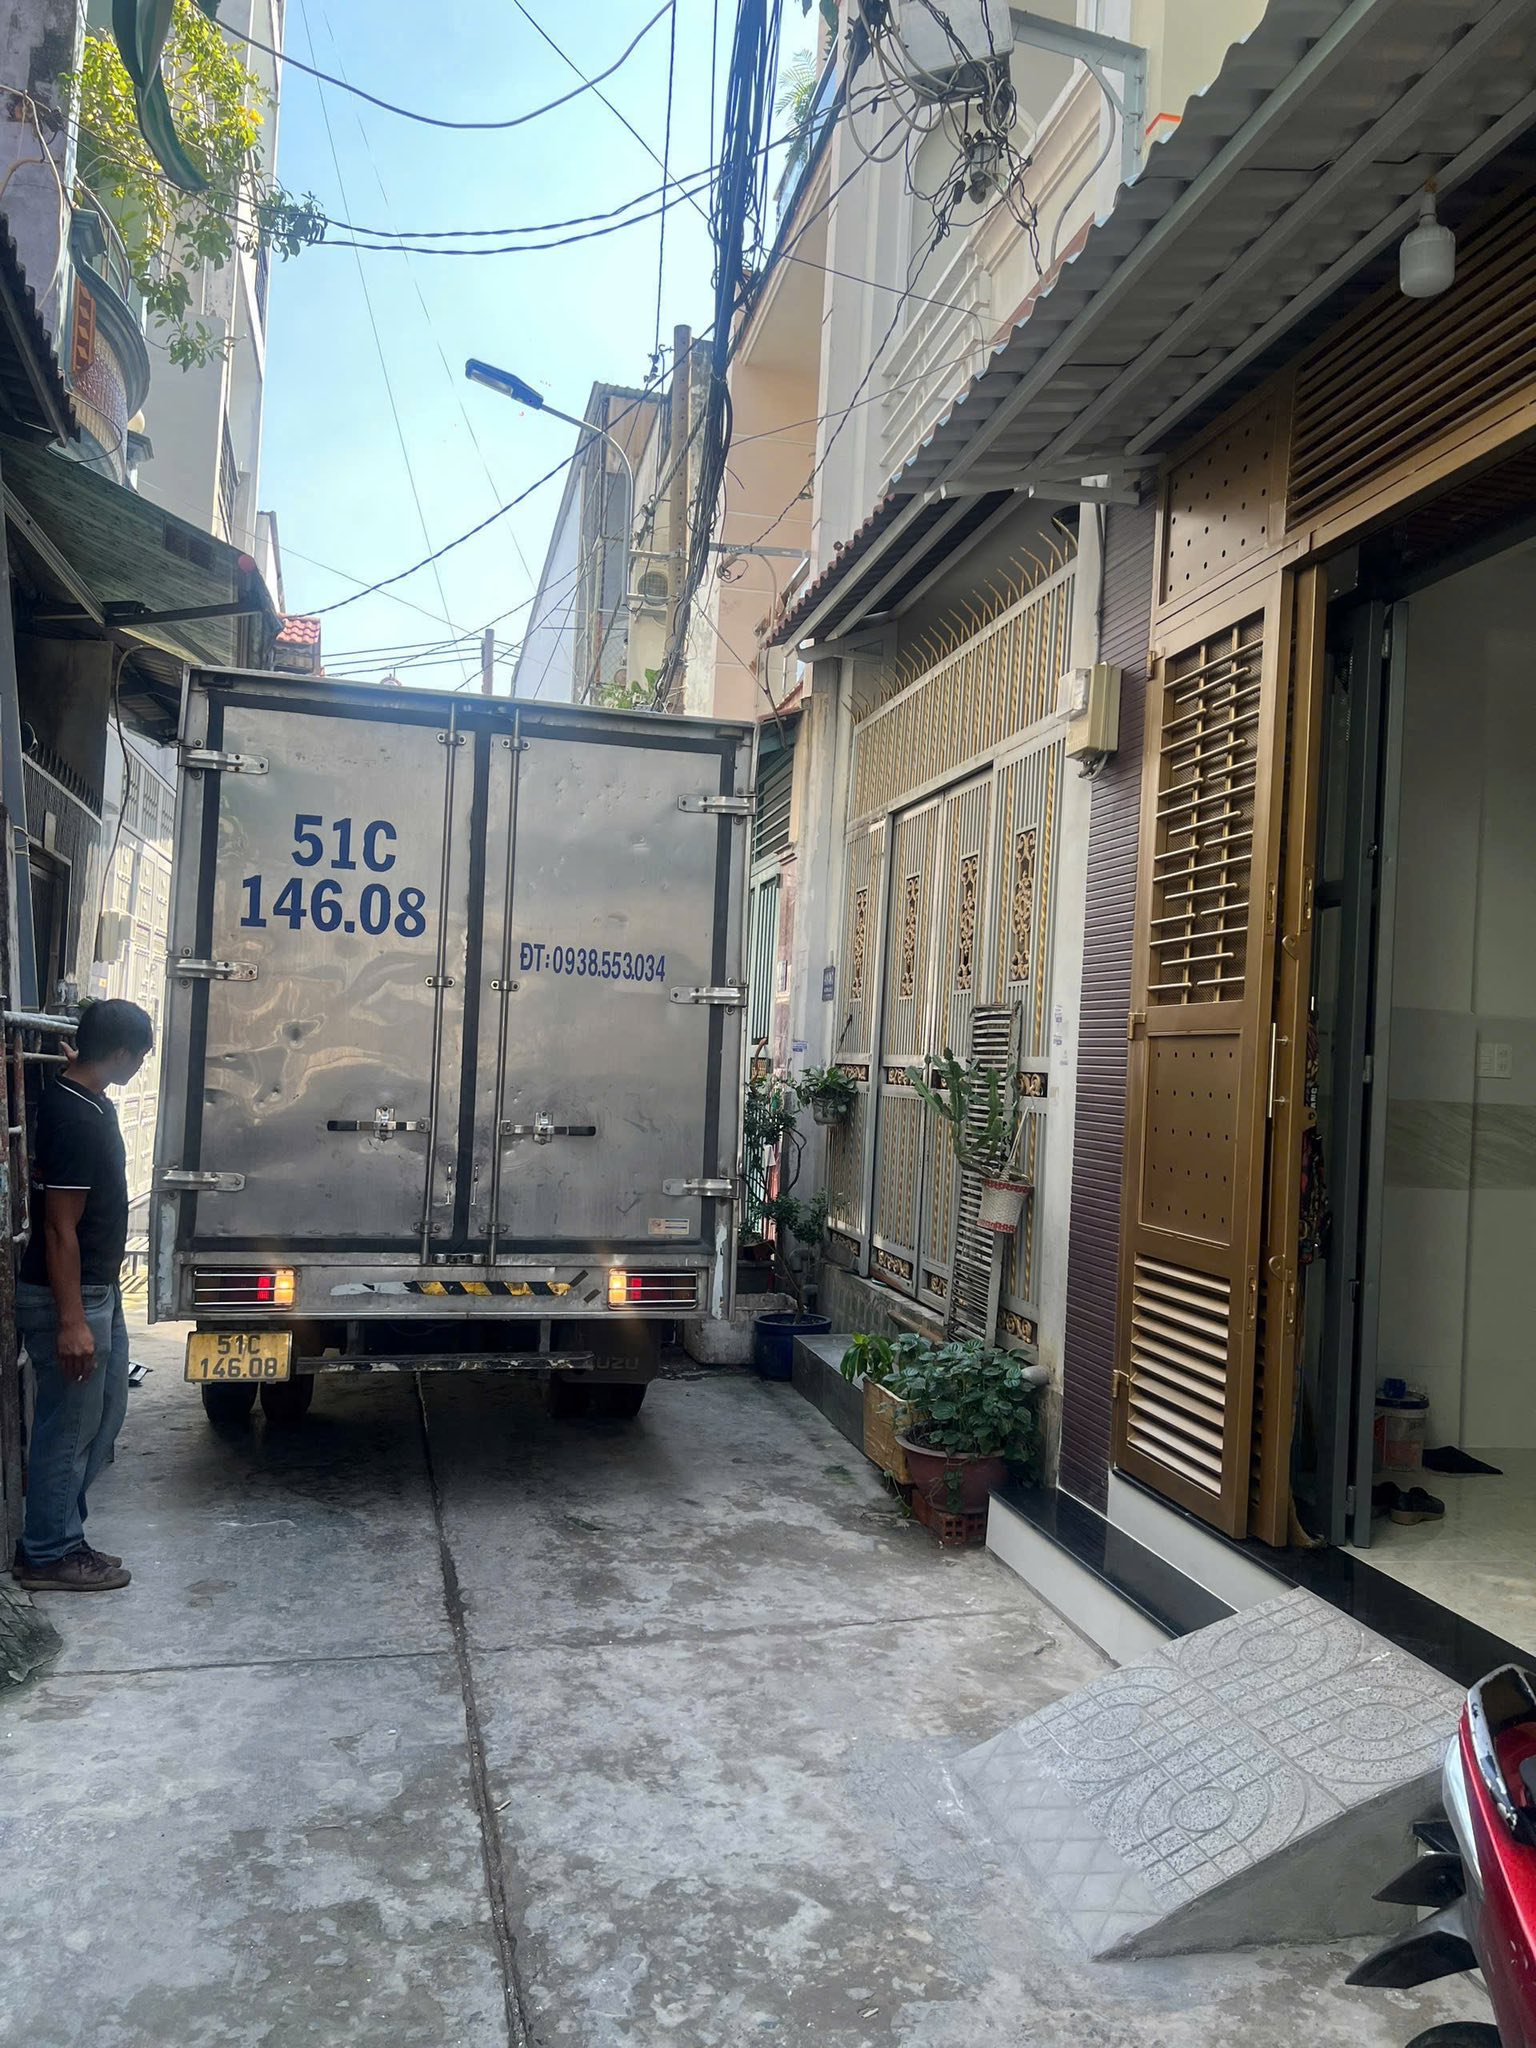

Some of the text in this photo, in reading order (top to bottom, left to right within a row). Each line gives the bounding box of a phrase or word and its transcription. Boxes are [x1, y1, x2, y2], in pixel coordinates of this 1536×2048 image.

[291, 813, 397, 873] 51C
[240, 874, 426, 938] 146.08
[520, 942, 665, 982] ĐT:0938.553.034
[217, 1334, 261, 1355] 51C
[200, 1357, 278, 1378] 146.08
